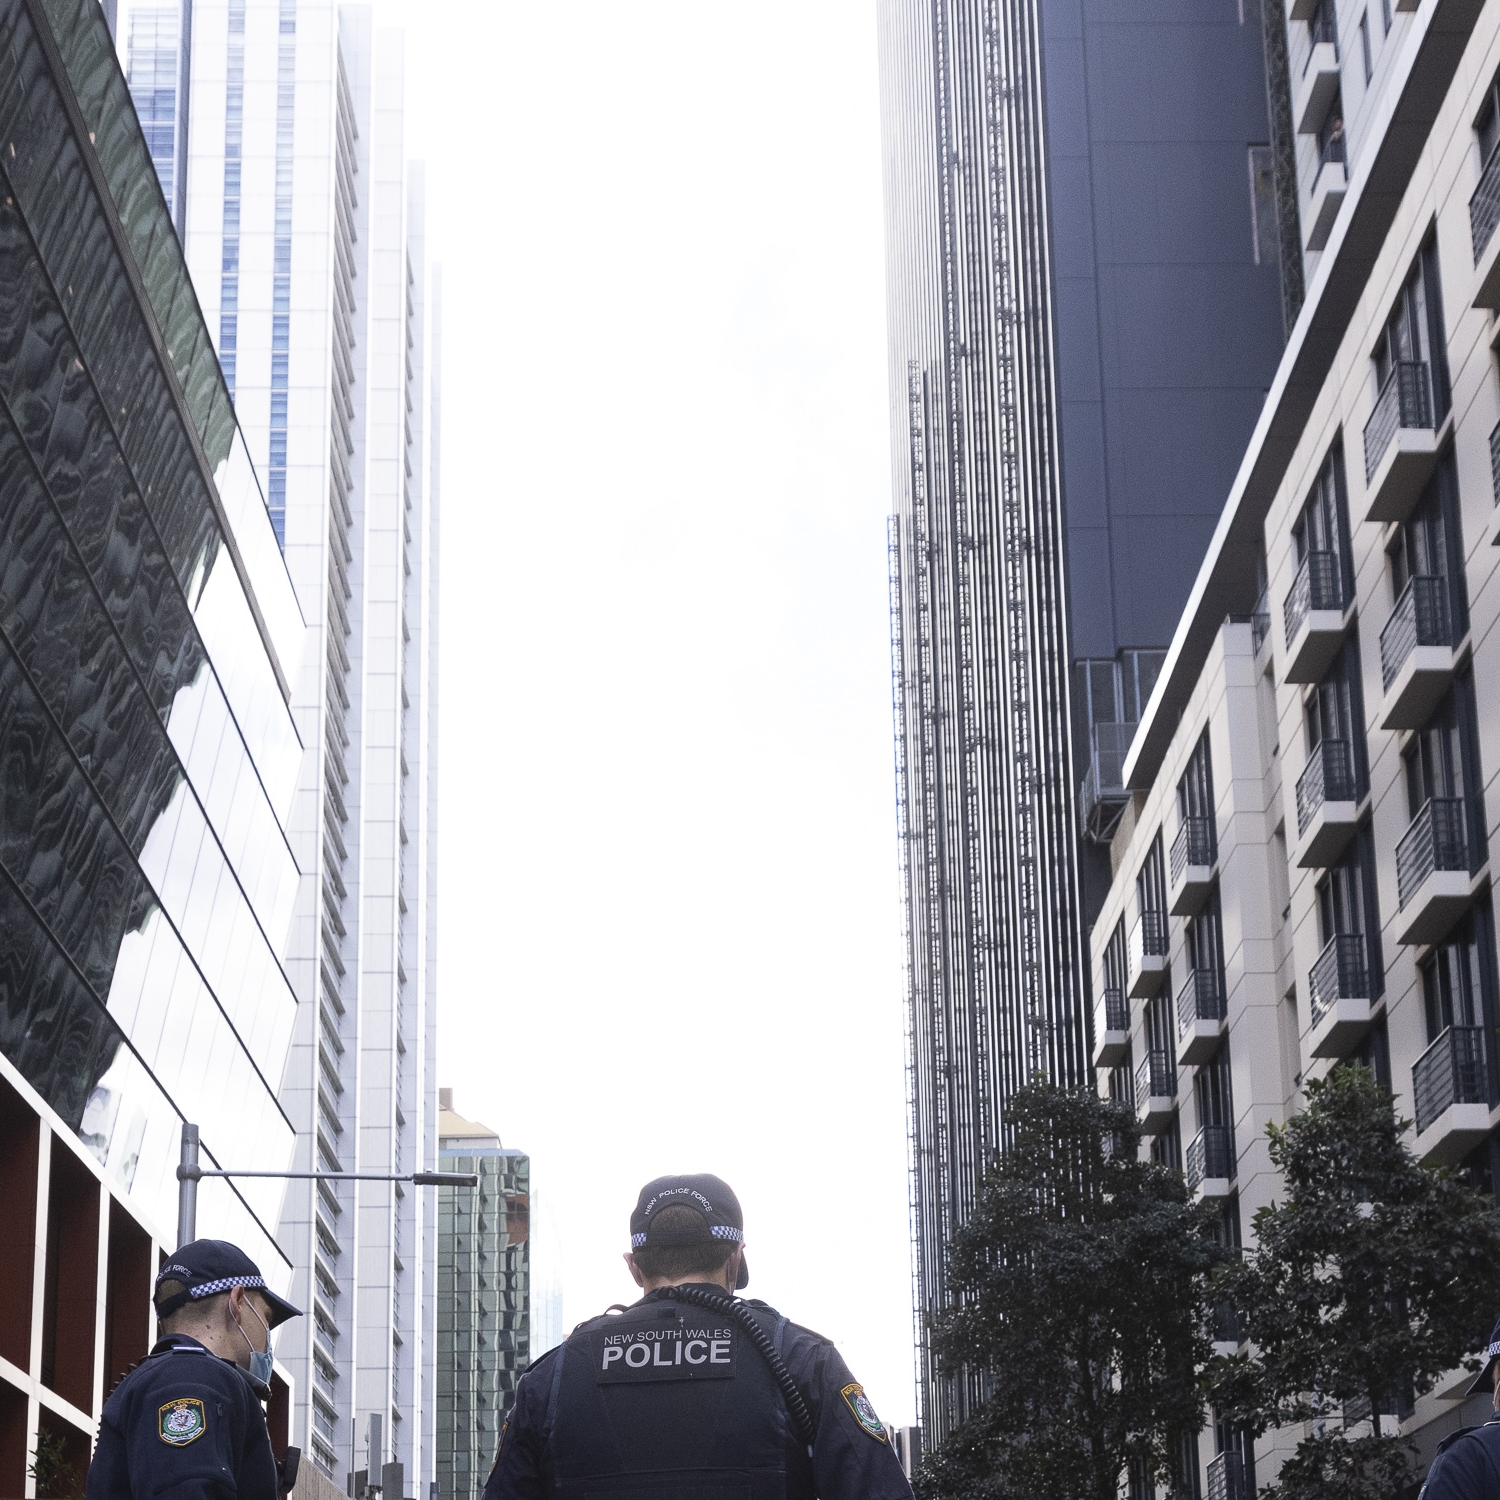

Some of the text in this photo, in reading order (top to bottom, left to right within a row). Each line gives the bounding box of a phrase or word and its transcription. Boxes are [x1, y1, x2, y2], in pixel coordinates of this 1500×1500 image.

[645, 1187, 713, 1215] NSW POLICE FORCE
[604, 1328, 732, 1345] NEW SOUTH WALES
[602, 1340, 731, 1370] POLICE
